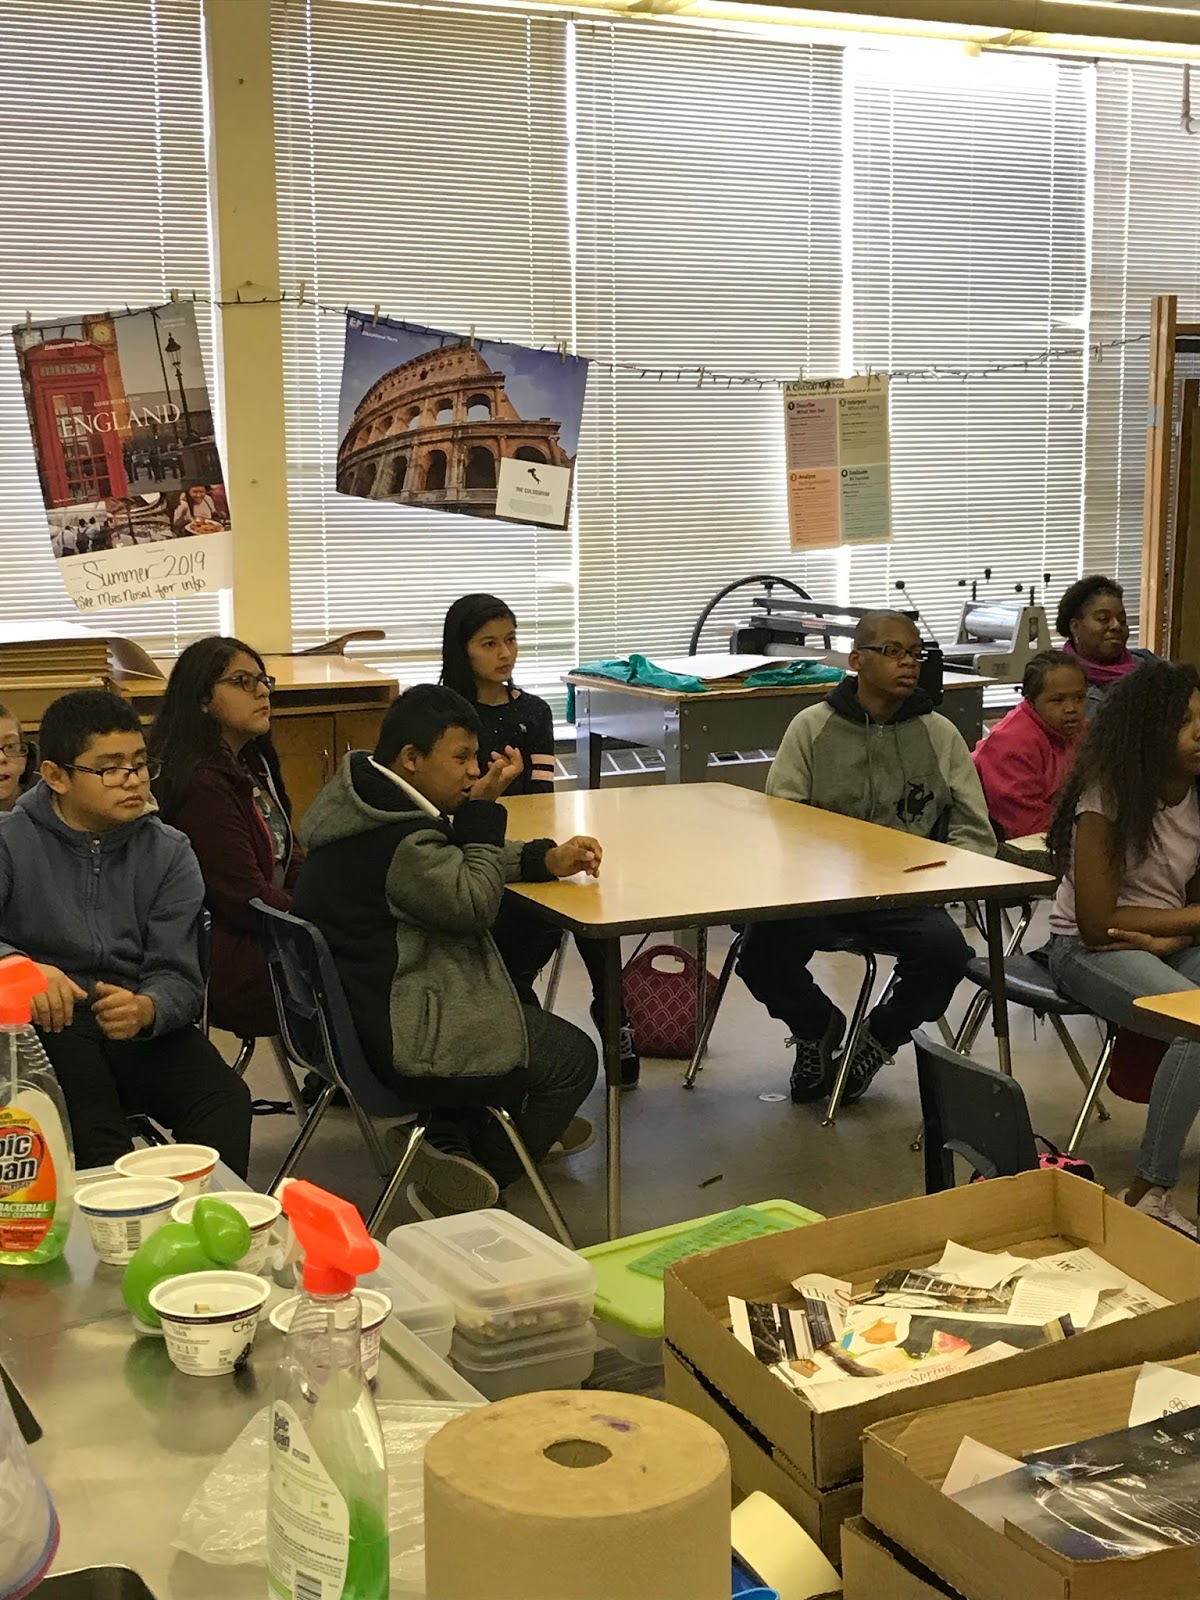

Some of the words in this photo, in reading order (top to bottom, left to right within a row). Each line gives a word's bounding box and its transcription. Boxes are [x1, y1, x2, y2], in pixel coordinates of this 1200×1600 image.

[820, 380, 845, 389] Mthod
[60, 403, 180, 438] ENGLAND
[82, 560, 153, 591] Summer
[163, 550, 206, 578] 2019
[155, 583, 177, 599] for
[182, 576, 206, 592] info
